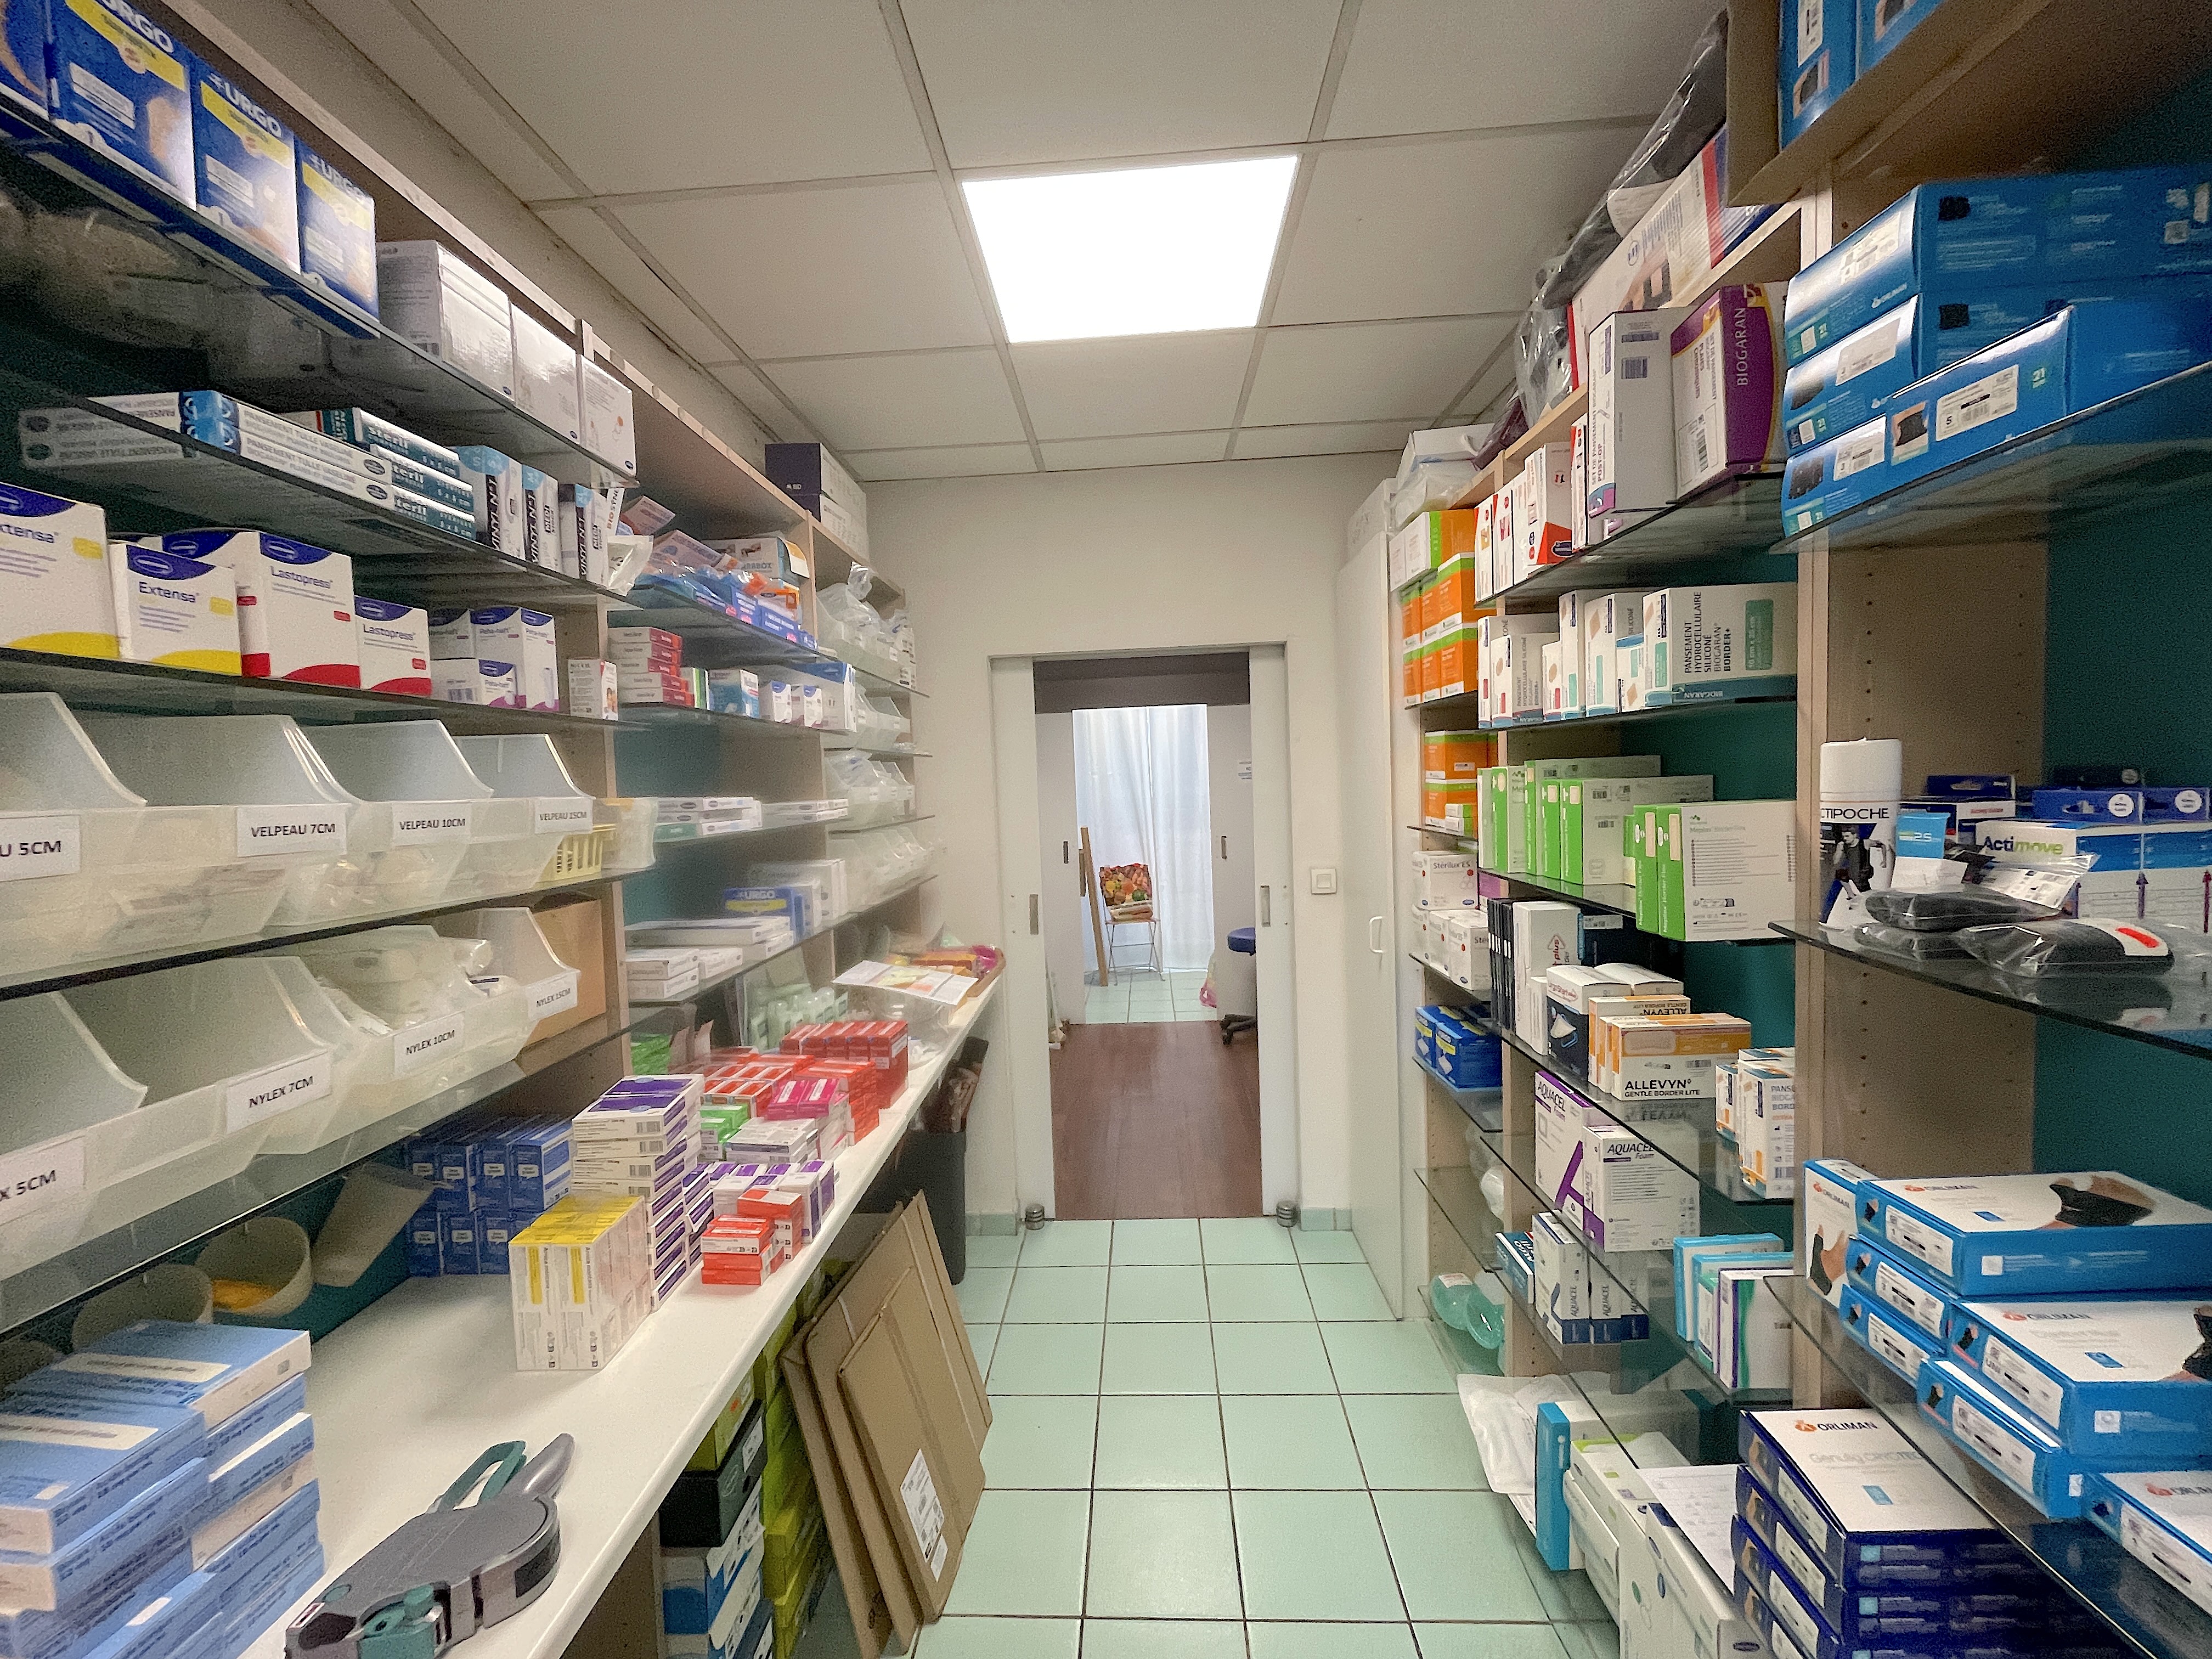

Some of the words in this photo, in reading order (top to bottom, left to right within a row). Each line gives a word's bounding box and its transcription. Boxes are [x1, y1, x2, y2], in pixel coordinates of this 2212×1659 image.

[223, 83, 283, 138] URGO
[1737, 307, 1747, 386] BIOGARAN
[1946, 415, 1953, 425] 5
[392, 462, 424, 483] teril
[394, 499, 427, 516] teril
[270, 566, 331, 589] Lastopress
[138, 582, 196, 603] Extensa
[362, 623, 414, 641] Lastopress
[1694, 591, 1702, 673] HYDROCELLULAIRE
[1684, 621, 1692, 673] PANSEMENT
[1702, 634, 1712, 673] SILICONÉ
[1713, 627, 1722, 672] BIOGARAN
[1723, 628, 1731, 672] BORDER+
[539, 812, 568, 822] VELPEAU
[569, 810, 588, 820] 15CM
[1820, 808, 1889, 819] CTIPOCHE
[251, 823, 307, 838] VELPEAU
[310, 823, 336, 836] 7CM
[399, 820, 439, 831] VELPEAU
[442, 818, 466, 829] 10CM
[18, 840, 62, 856] 5CM
[1984, 836, 2063, 855] Actimove
[535, 995, 554, 1008] NYLEX
[1643, 1007, 1688, 1016] ALLEVYN
[405, 1039, 432, 1056] NYLEX
[433, 1030, 456, 1045] 10CM
[249, 1086, 287, 1109] NYLEX
[288, 1075, 314, 1093] 7CM
[1624, 1079, 1688, 1091] ALLEVYN
[1624, 1090, 1652, 1098] GENTLE
[1537, 1081, 1566, 1112] AQUACEL
[1607, 1142, 1654, 1154] AQUACEL
[16, 1169, 57, 1197] 5CM
[1822, 1189, 1851, 1209] ORLIMAN
[1570, 1285, 1579, 1317] AQUACEL
[1601, 1285, 1611, 1317] AQUACEL
[1817, 1421, 1878, 1431] ORLIMAN
